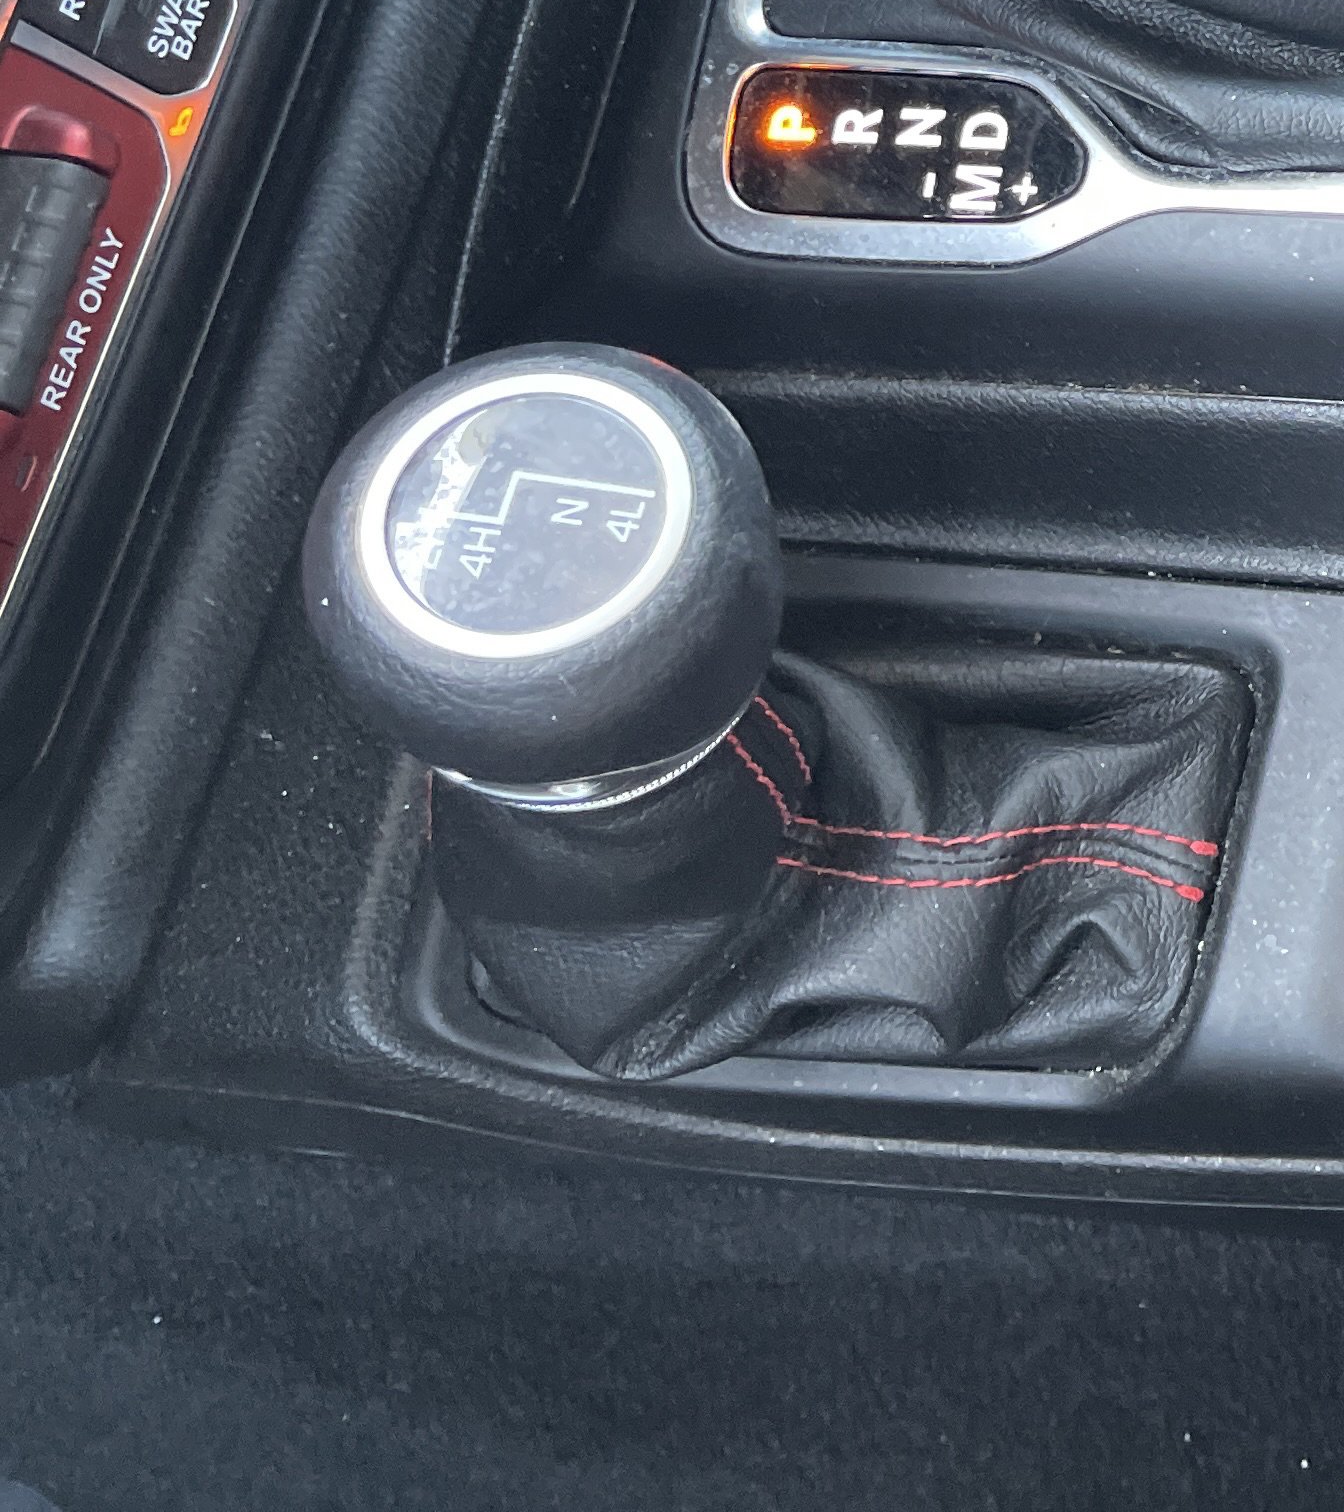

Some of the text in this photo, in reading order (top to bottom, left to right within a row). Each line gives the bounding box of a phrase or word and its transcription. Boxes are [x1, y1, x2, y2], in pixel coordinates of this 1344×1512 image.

[766, 104, 1010, 151] P R N D
[947, 163, 1004, 214] M
[39, 226, 126, 412] REAR ONLY
[551, 497, 590, 526] N
[606, 501, 645, 543] 4L
[458, 525, 502, 580] 4H
